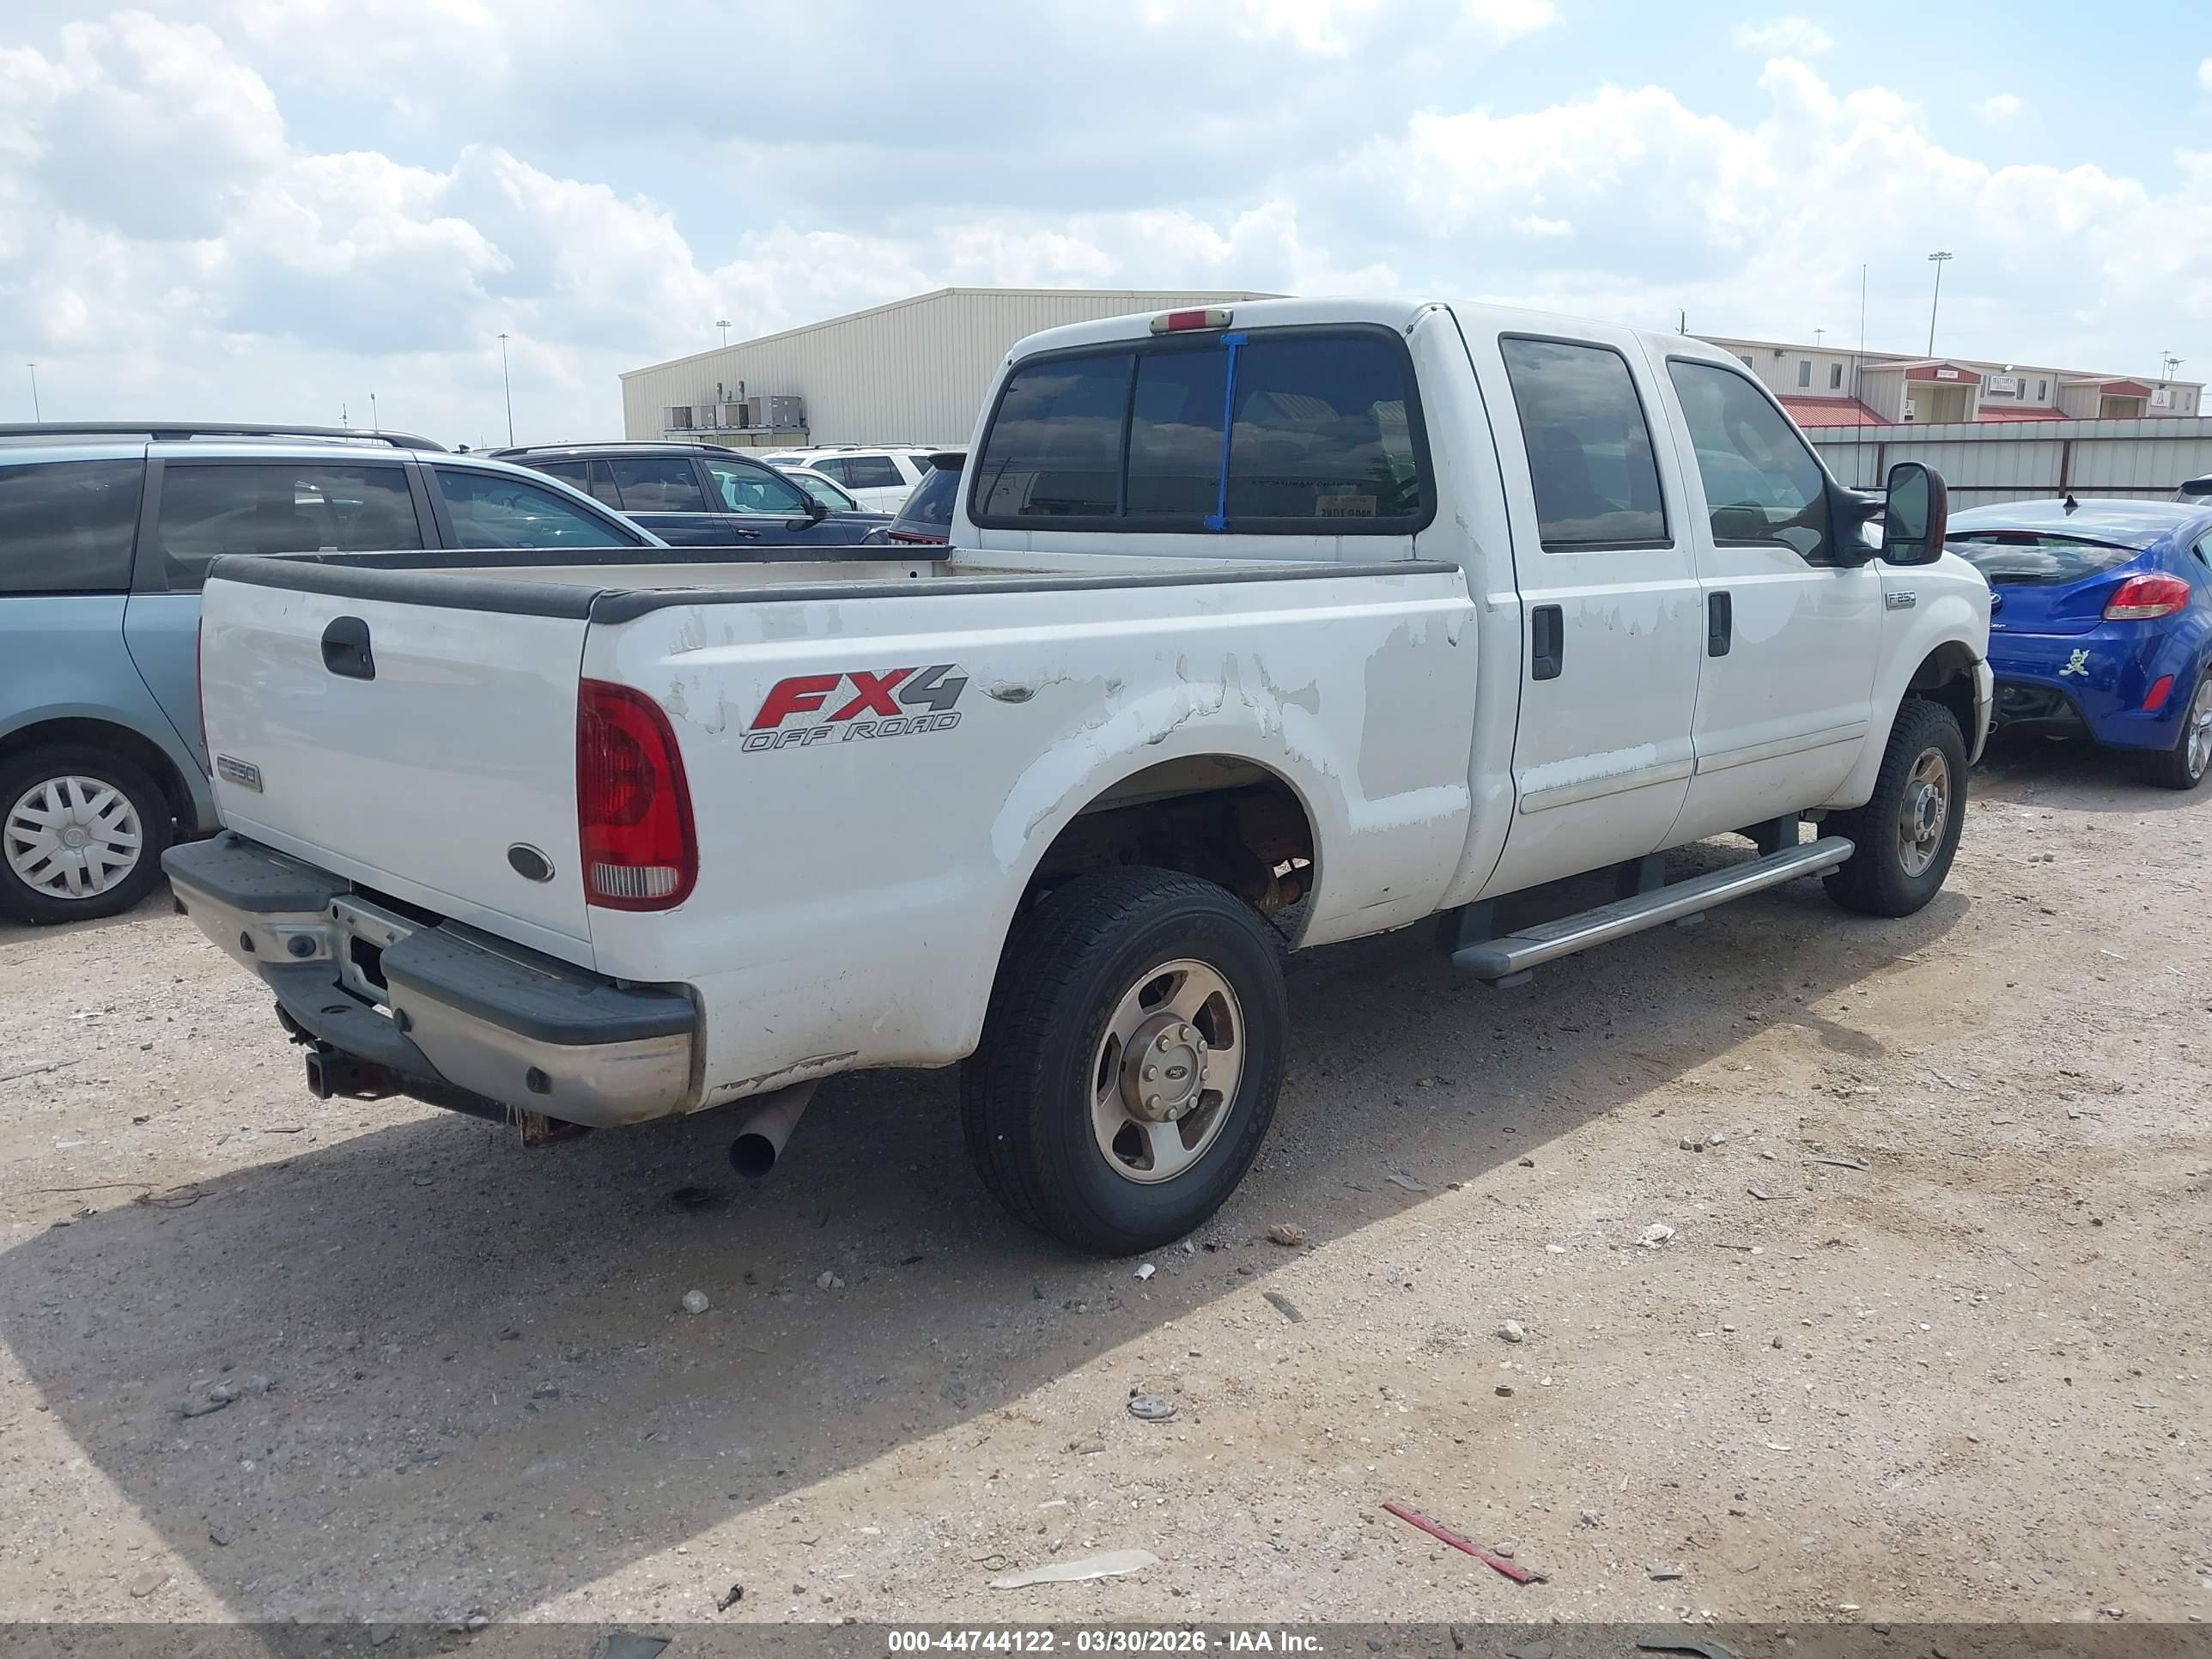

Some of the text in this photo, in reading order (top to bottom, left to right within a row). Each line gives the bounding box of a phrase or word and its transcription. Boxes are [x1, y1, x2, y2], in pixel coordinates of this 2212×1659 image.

[750, 664, 969, 730] FX4
[742, 713, 961, 752] OFF ROAD
